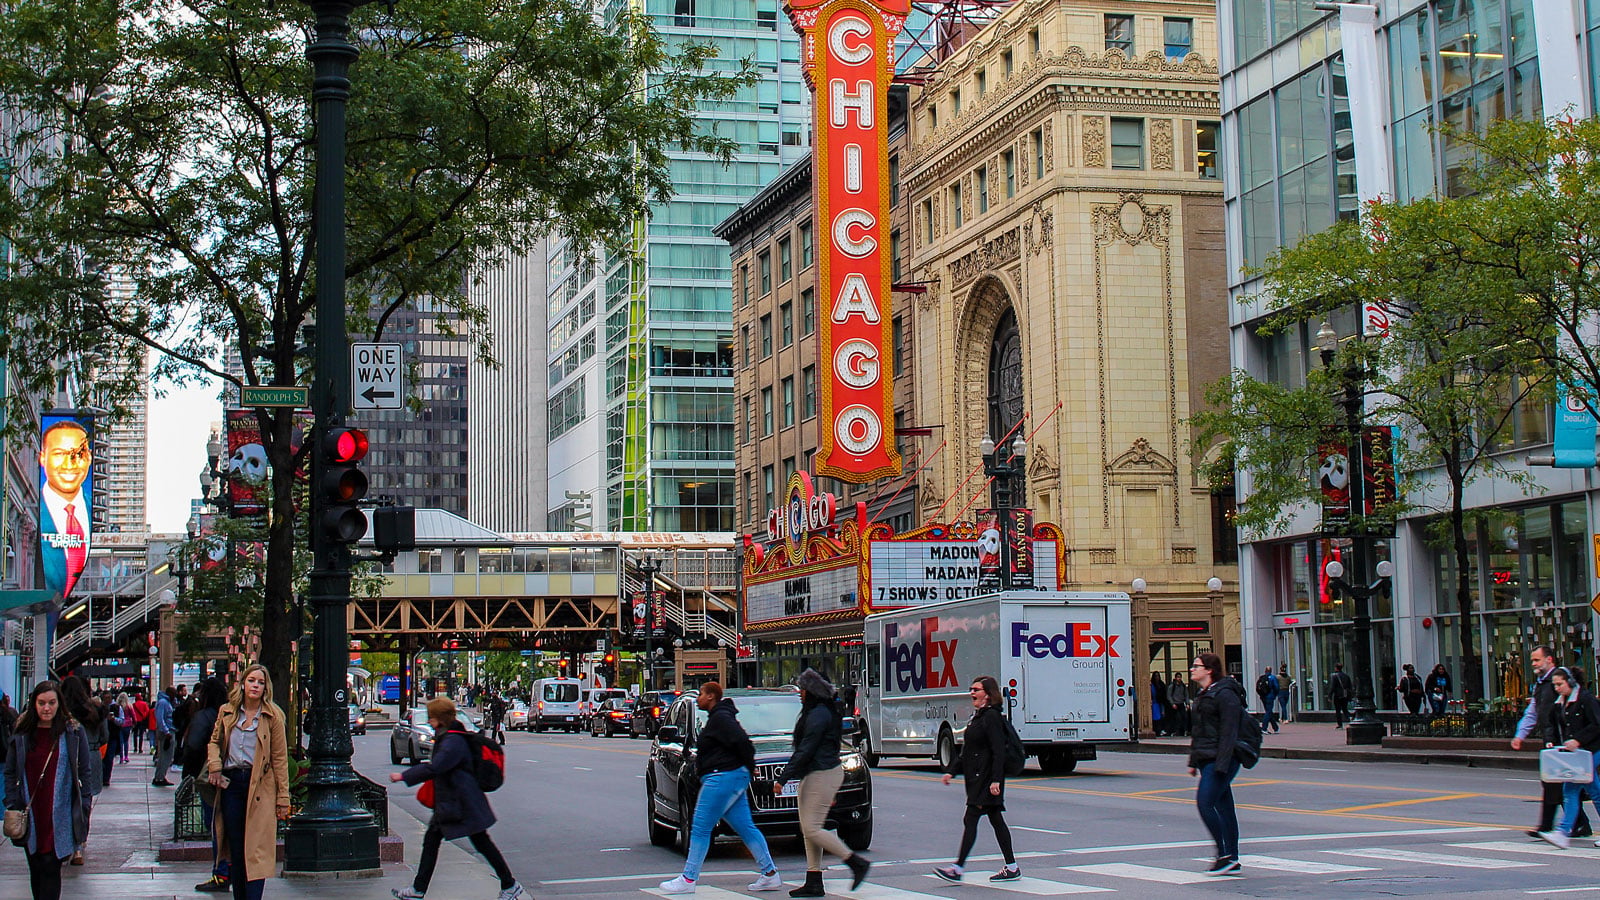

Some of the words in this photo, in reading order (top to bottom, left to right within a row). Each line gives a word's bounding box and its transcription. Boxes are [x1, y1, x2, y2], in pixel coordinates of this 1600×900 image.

[827, 16, 882, 456] CHICAGO
[358, 349, 395, 364] ONE
[358, 367, 396, 383] WAY
[767, 492, 829, 540] CHICAGO
[52, 541, 82, 549] BROWN
[1016, 511, 1026, 569] PHANTOM
[925, 566, 980, 580] MADAM
[878, 587, 885, 600] 7
[889, 587, 938, 600] SHOWS
[1011, 622, 1120, 658] FedEx
[885, 616, 959, 692] FedEx
[1072, 659, 1104, 669] Ground
